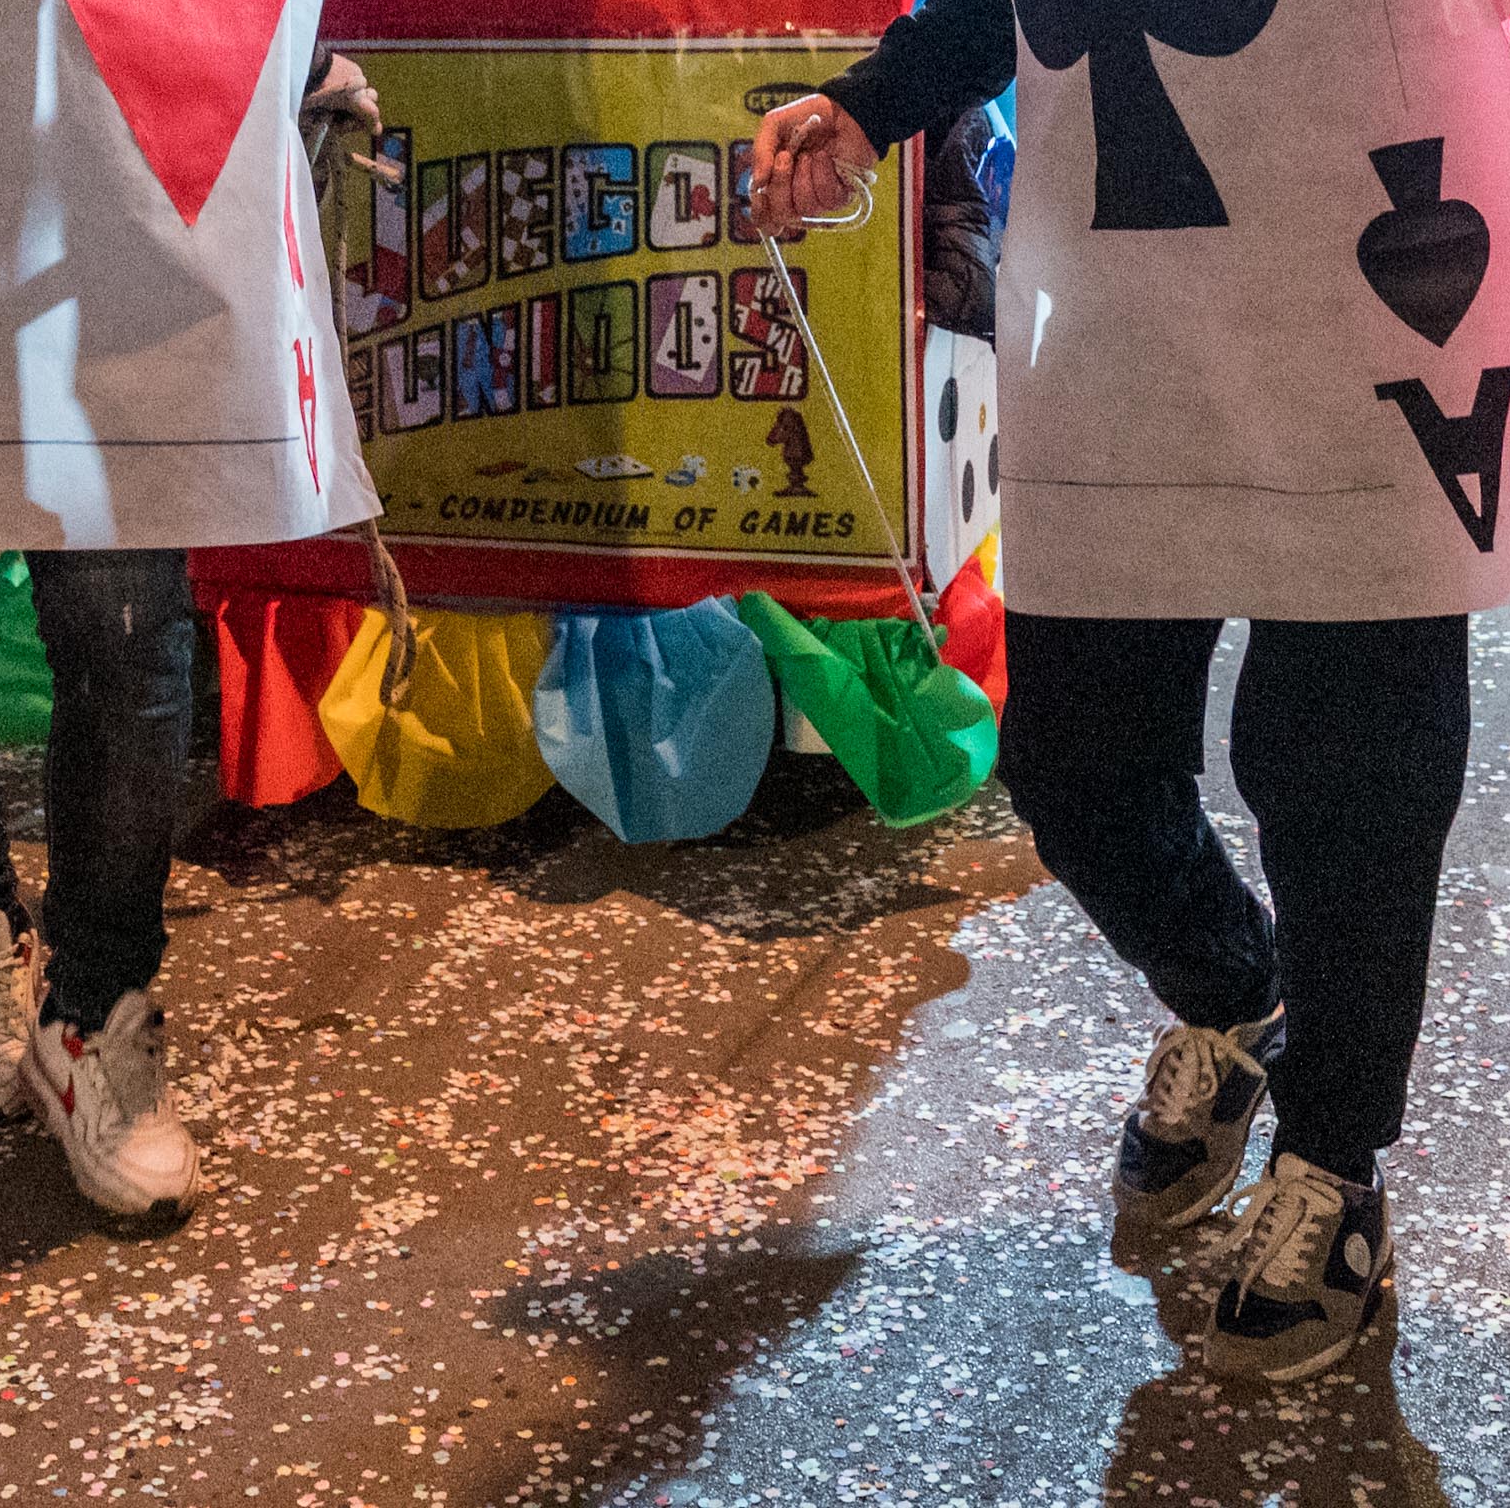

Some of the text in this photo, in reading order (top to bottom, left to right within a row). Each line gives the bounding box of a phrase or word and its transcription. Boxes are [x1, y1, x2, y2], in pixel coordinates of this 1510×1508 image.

[440, 494, 856, 539] COMPENDIUM OF GAMES
